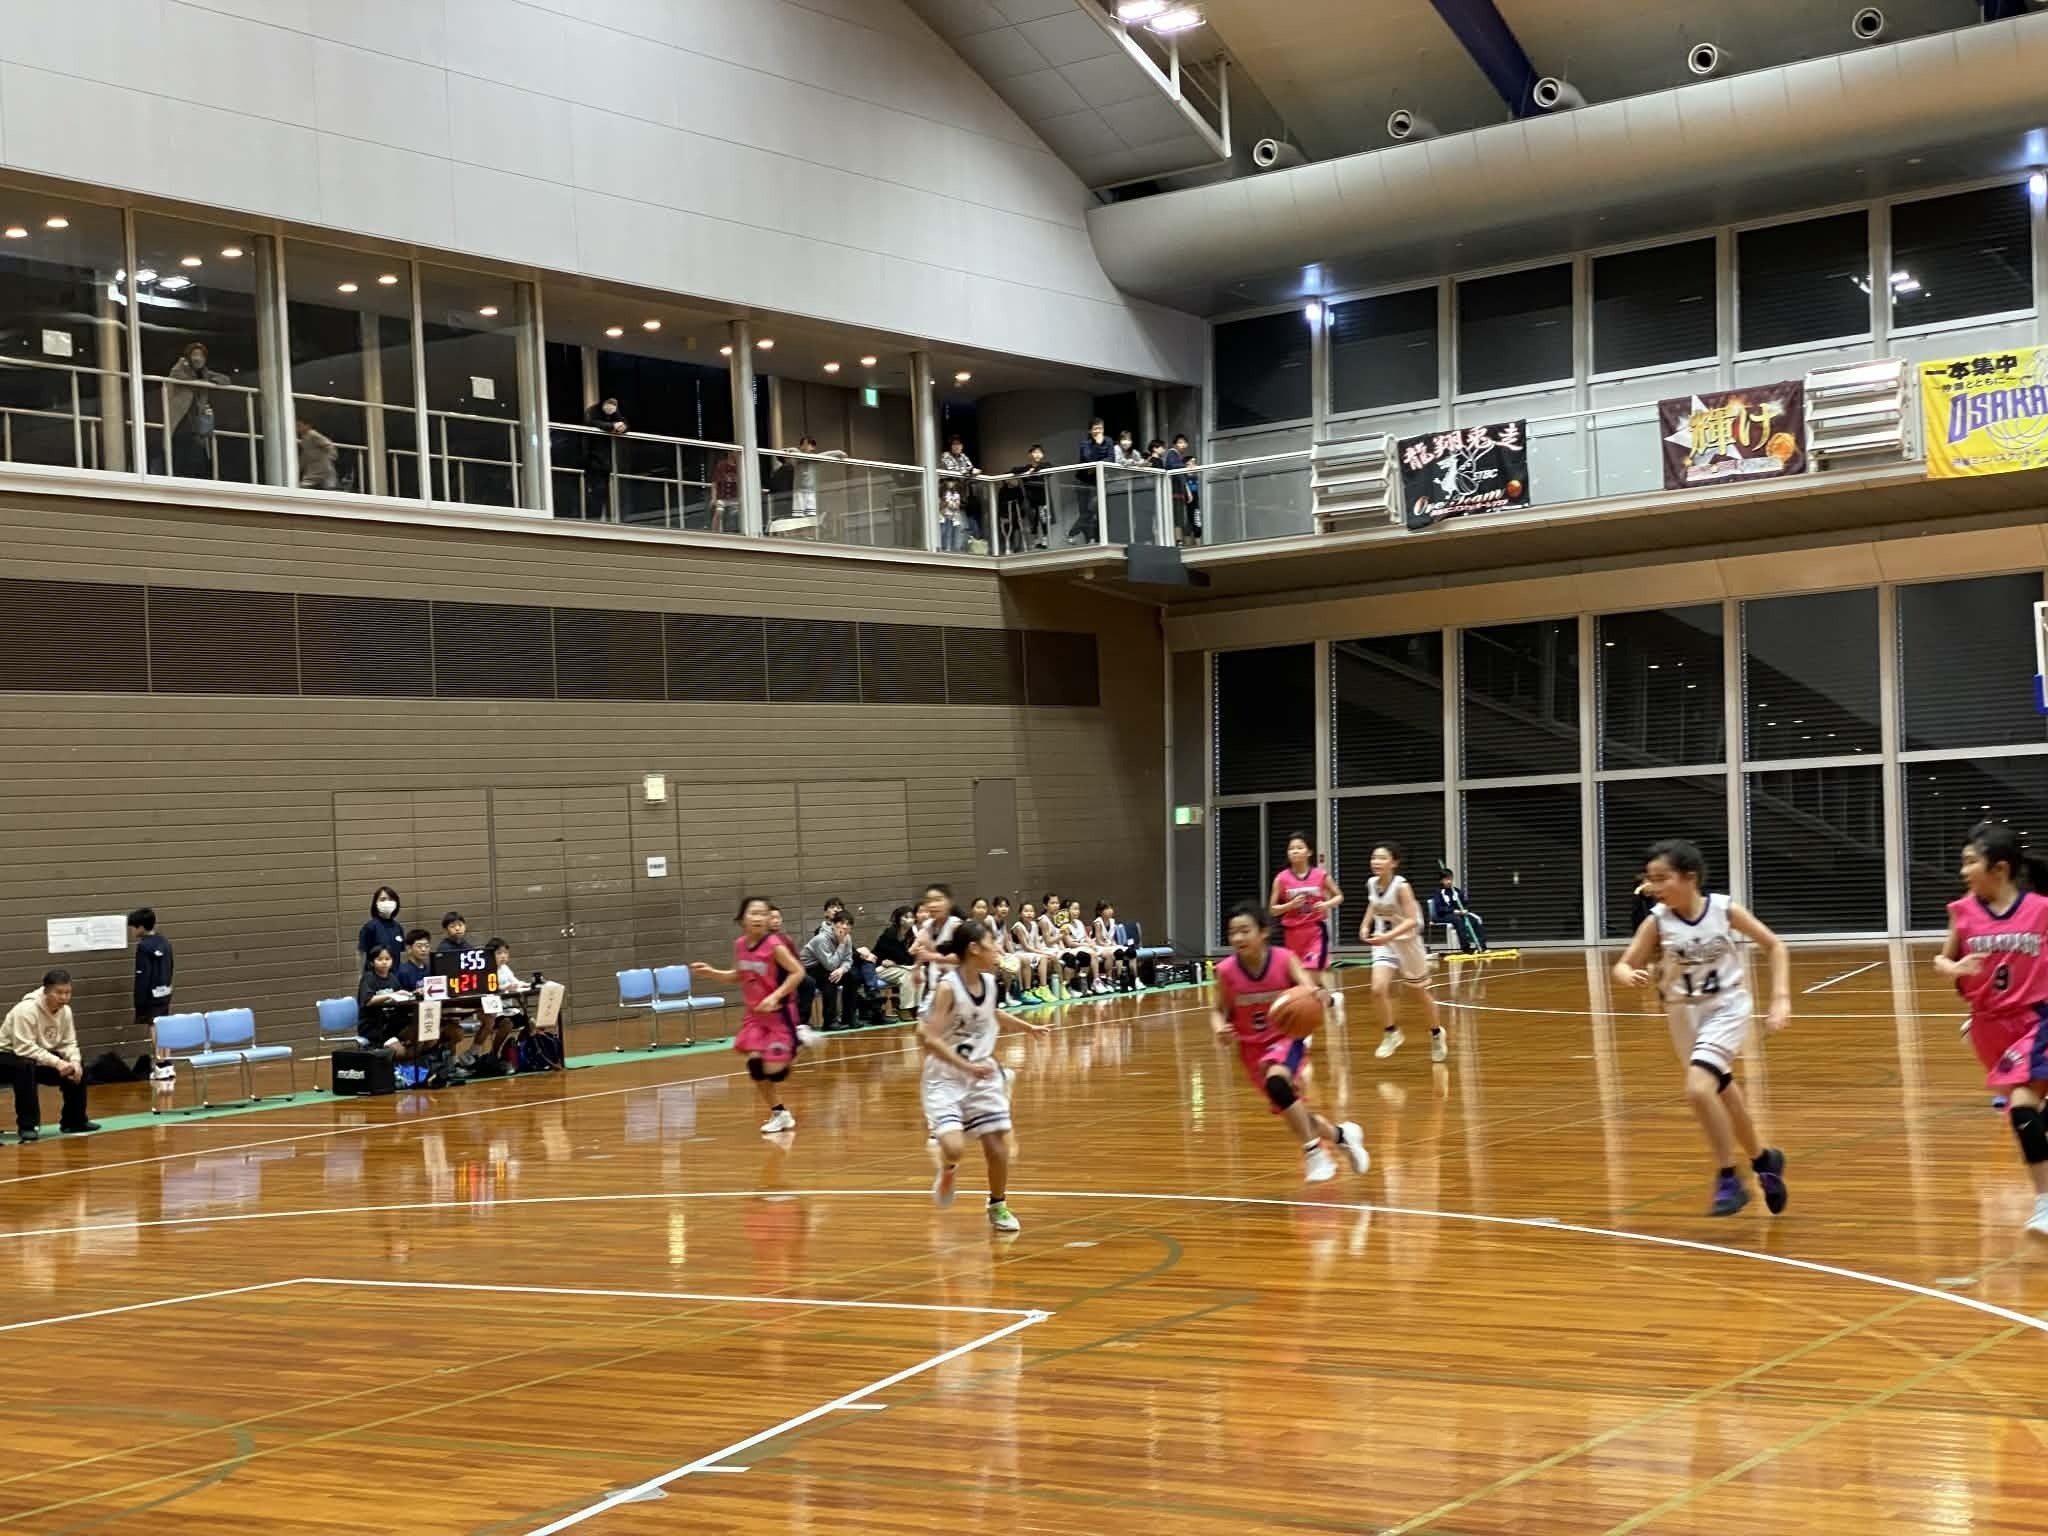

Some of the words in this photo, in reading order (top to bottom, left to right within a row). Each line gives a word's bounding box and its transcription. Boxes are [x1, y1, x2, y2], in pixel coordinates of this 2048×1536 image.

[1924, 354, 2017, 380] 一本集中
[1947, 385, 2048, 444] OSAKA
[1687, 402, 1777, 456] 輝け
[460, 950, 486, 970] 1:55
[1682, 968, 1721, 996] 14
